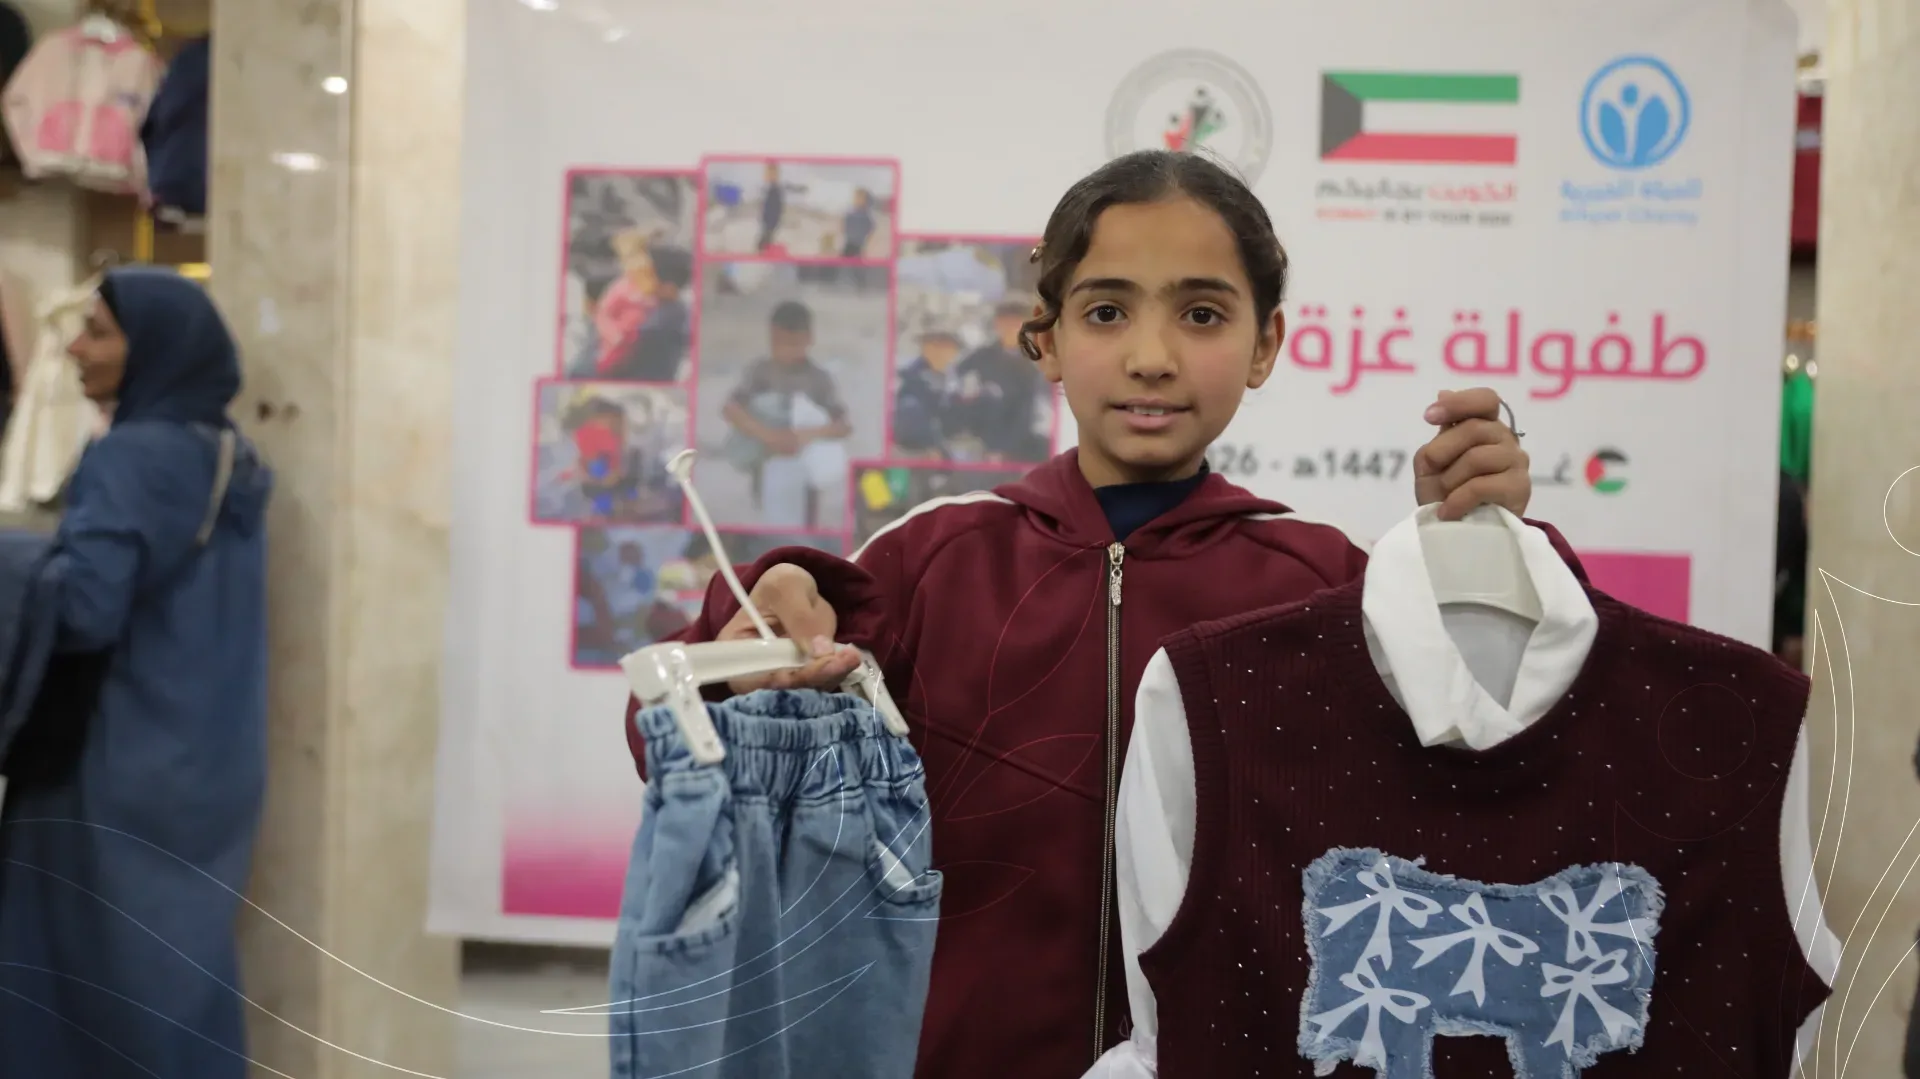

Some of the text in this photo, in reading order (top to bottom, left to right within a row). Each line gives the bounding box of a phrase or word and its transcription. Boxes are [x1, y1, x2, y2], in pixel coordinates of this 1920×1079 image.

[1289, 306, 1707, 399] طفولة غزة
[1207, 443, 1259, 477] 26
